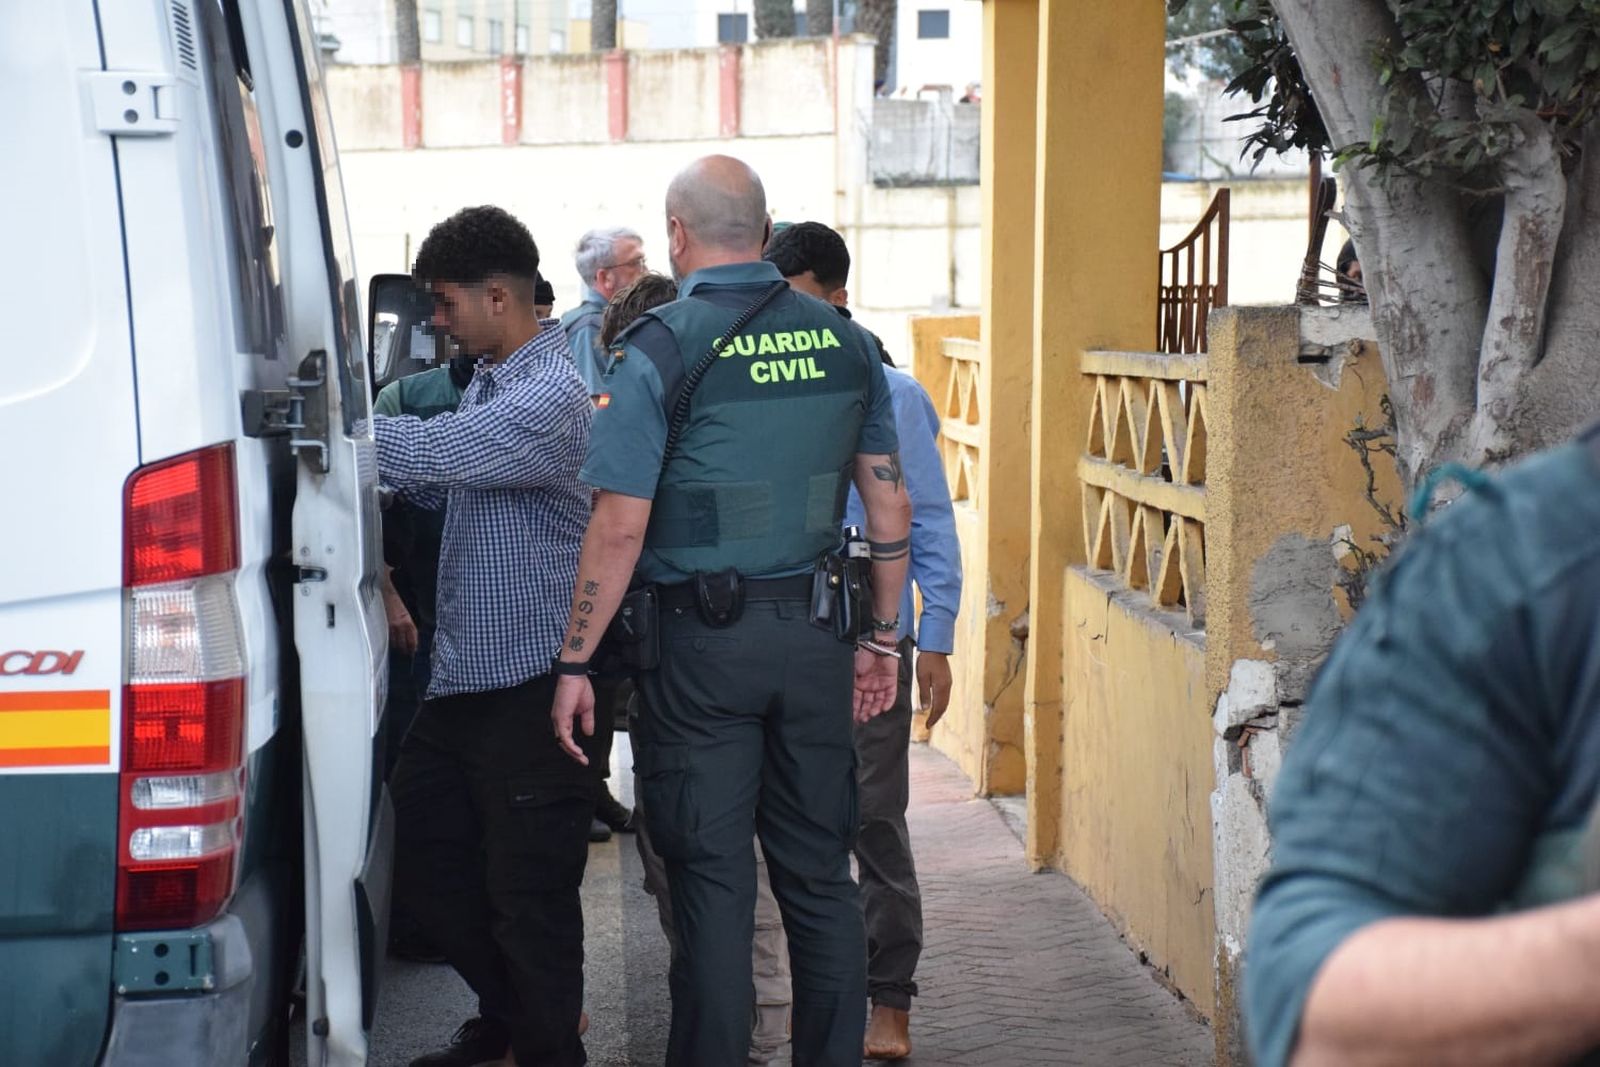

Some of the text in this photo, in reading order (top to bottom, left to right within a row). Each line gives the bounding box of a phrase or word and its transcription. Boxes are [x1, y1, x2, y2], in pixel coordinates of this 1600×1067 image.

[712, 328, 841, 358] GUARDIA
[750, 357, 826, 384] CIVIL
[0, 650, 85, 676] CDI
